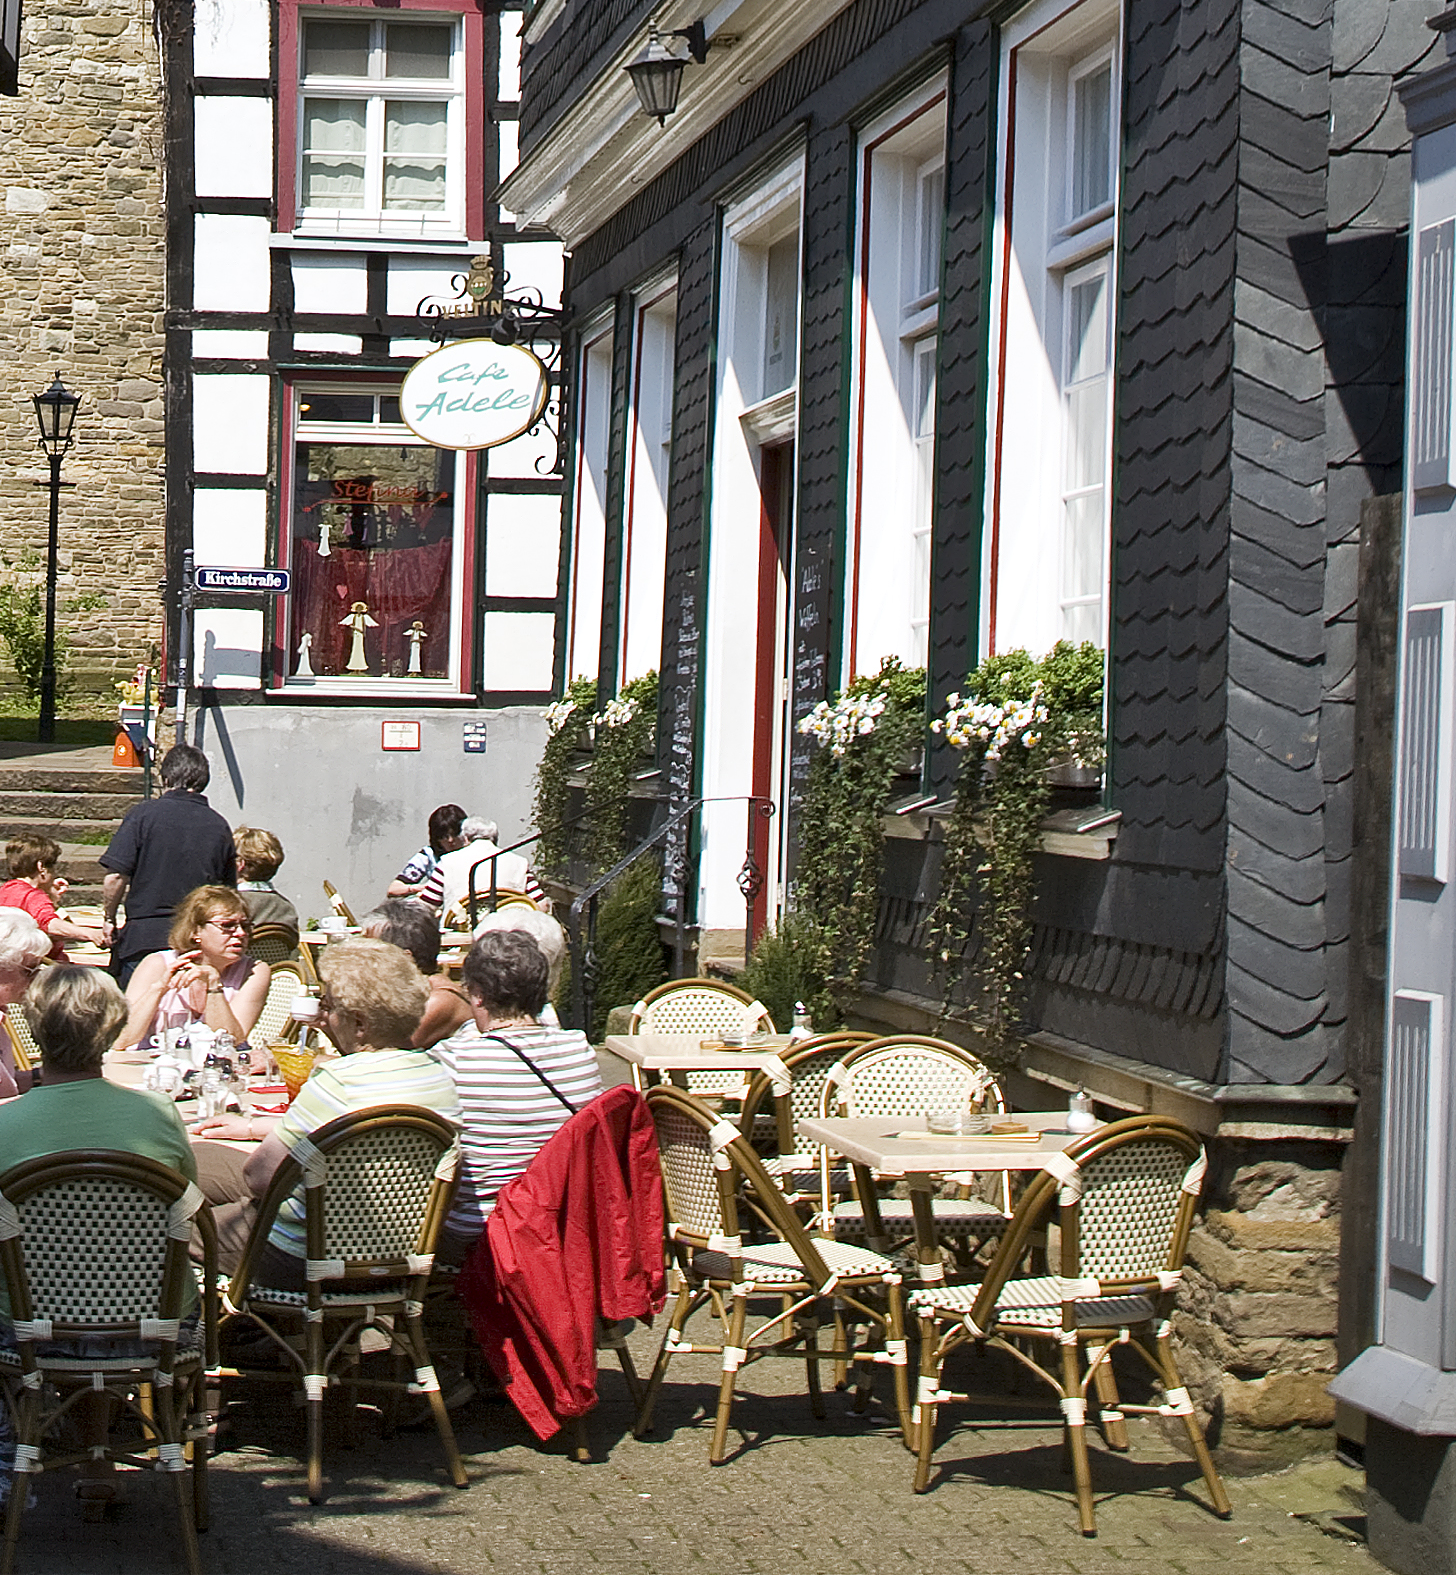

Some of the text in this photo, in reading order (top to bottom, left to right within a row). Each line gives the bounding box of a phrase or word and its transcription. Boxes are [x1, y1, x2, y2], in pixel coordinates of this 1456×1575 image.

[442, 299, 503, 320] VELTIN
[438, 362, 510, 386] Cafe
[416, 389, 531, 422] Adele
[205, 572, 282, 589] Kirchstraße
